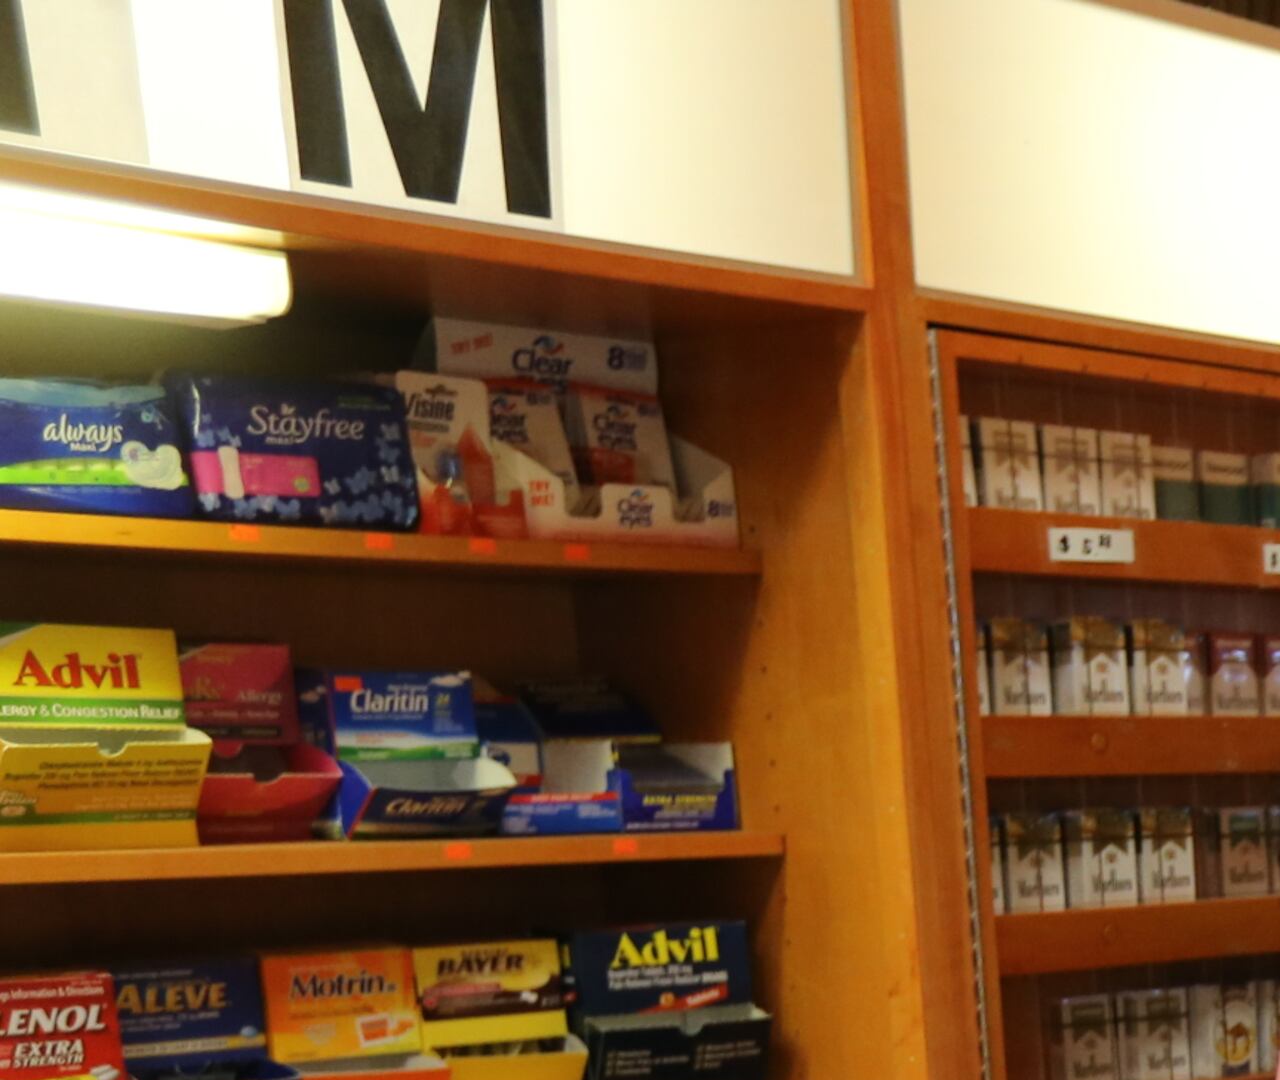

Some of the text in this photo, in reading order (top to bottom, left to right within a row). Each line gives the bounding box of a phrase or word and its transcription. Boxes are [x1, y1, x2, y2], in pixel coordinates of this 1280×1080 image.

[511, 348, 574, 377] Clear
[43, 413, 123, 453] always
[247, 404, 366, 445] Stayfree
[617, 499, 656, 513] Clear
[619, 511, 654, 528] eyes
[13, 649, 143, 689] Advil
[40, 704, 50, 717] &
[52, 702, 138, 719] CONGESTION
[140, 703, 181, 720] RELIEF
[350, 687, 429, 714] Claritin
[609, 925, 720, 968] Advil
[117, 981, 227, 1014] ALEVE
[288, 968, 386, 1000] Motrin
[13, 1053, 84, 1069] STRENGTH
[14, 1038, 84, 1058] EXTRA
